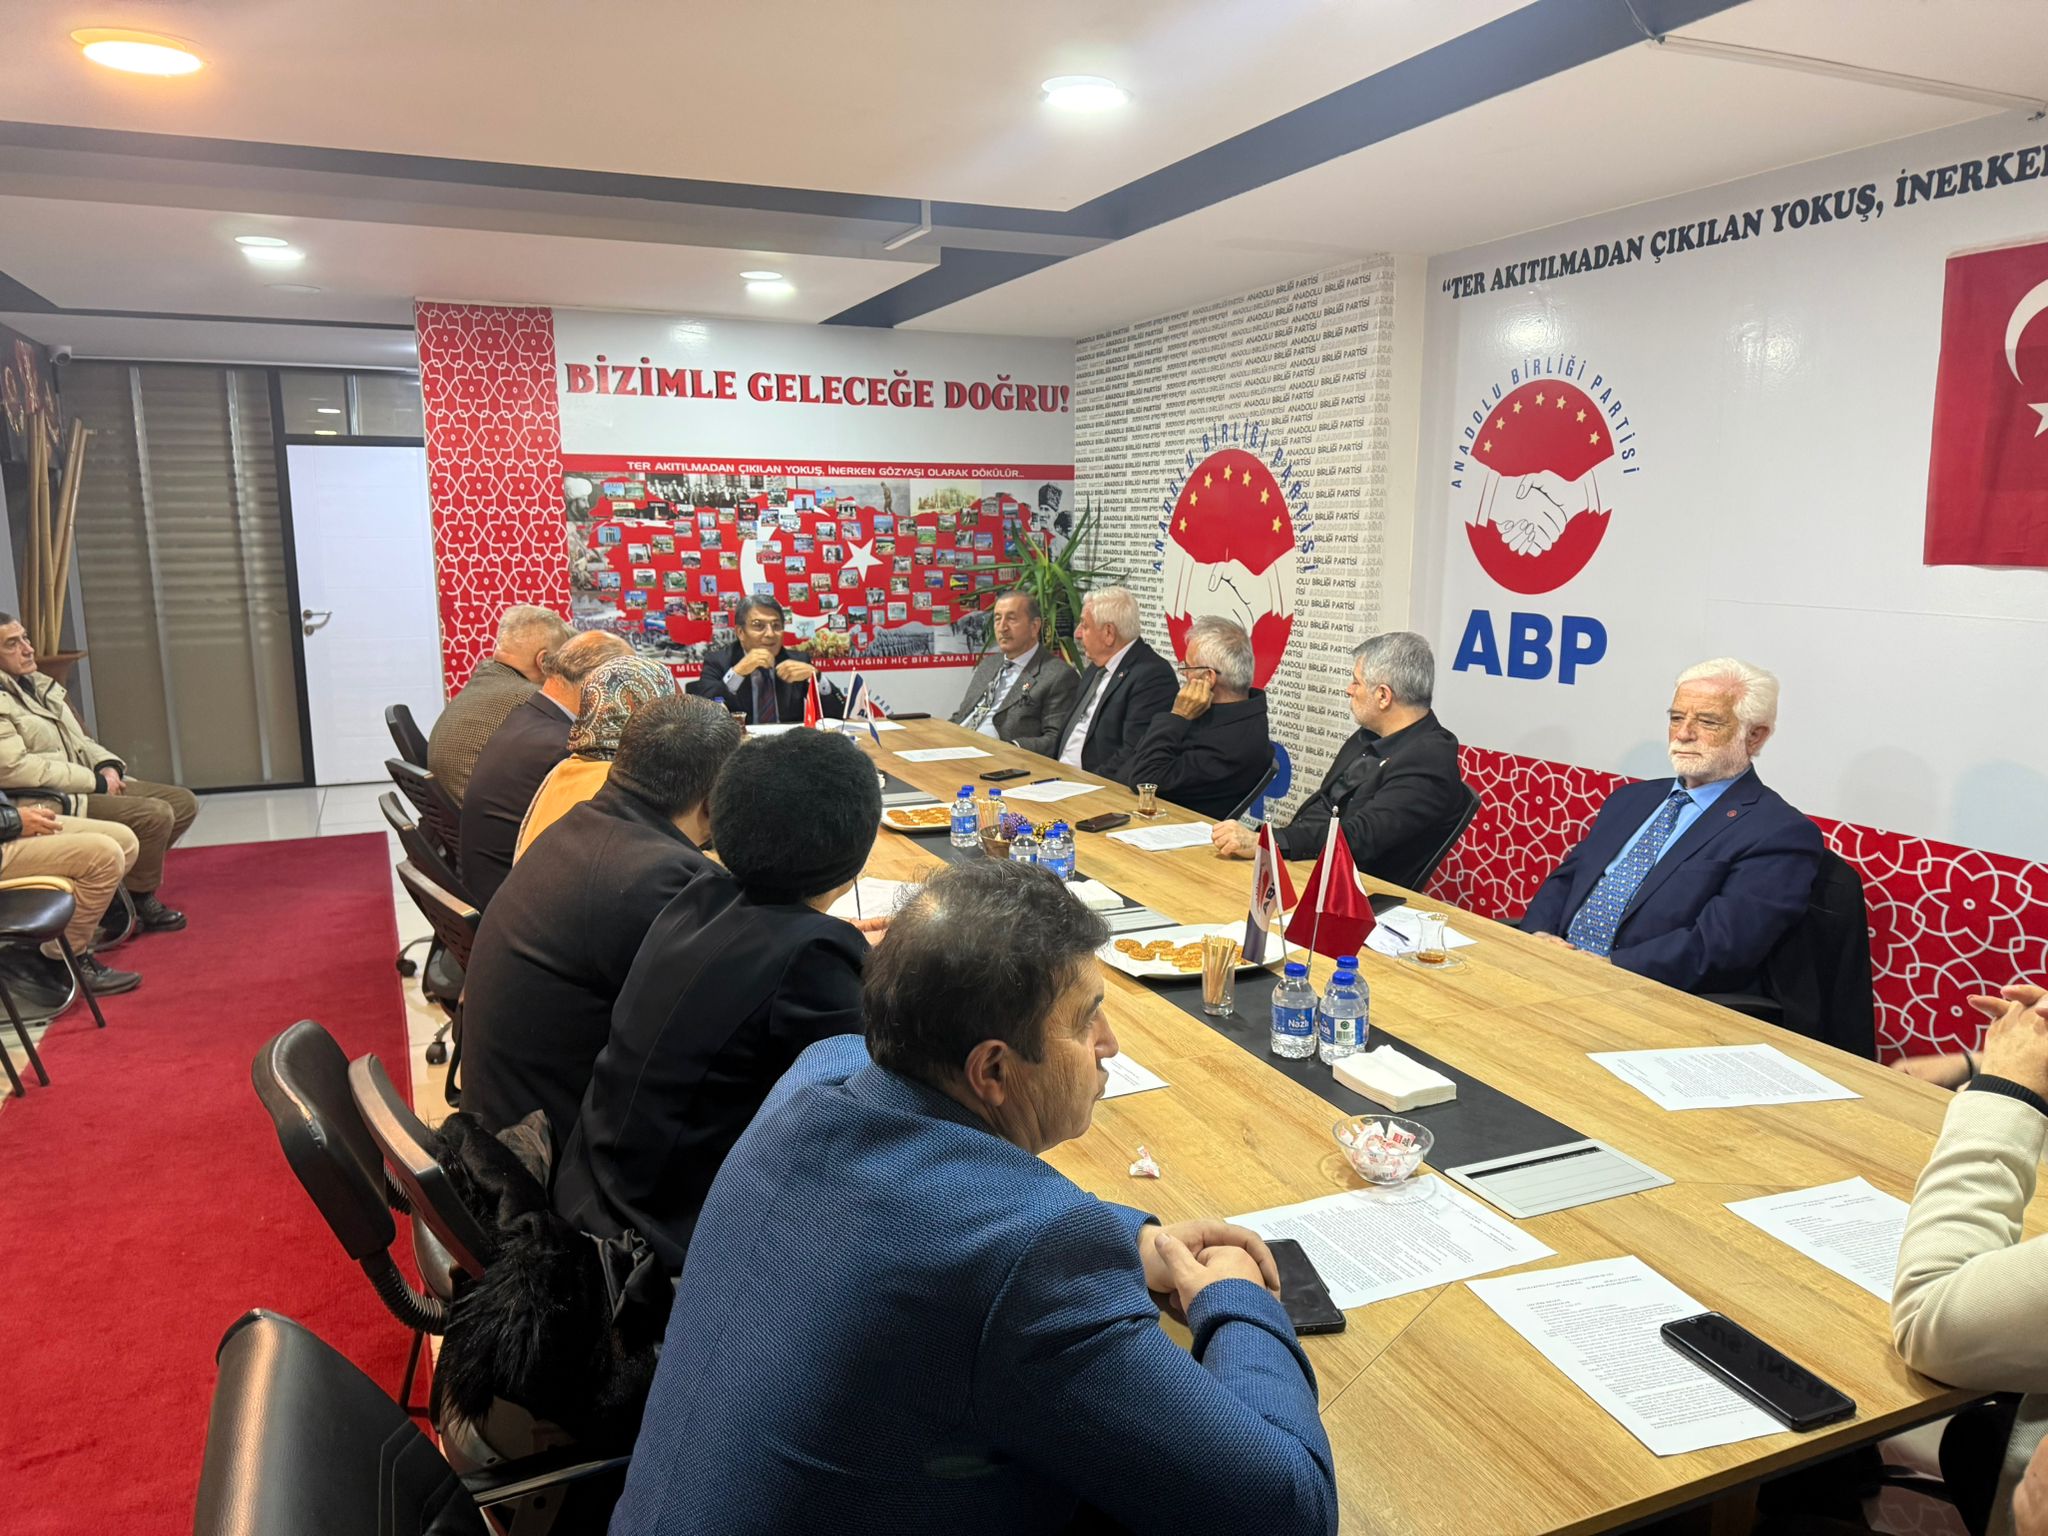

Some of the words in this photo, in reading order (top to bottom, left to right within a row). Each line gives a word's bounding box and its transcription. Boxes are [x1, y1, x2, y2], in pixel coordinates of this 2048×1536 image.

[1490, 236, 1644, 292] AKITILMADAN
[1650, 209, 1764, 263] ÇIKILAN
[1771, 184, 1884, 232] YOKUŞ,
[565, 354, 736, 400] BİZİMLE
[748, 370, 934, 408] GELECEĞE
[944, 374, 1070, 412] DOĞRU!
[1452, 384, 1502, 488] ANADOLU
[1511, 354, 1586, 385] BİRLİĞİ
[1591, 374, 1640, 474] PARTİSİ
[627, 462, 651, 470] TER
[655, 462, 734, 472] AKITILMADAN
[738, 464, 781, 474] ÇIKILAN
[828, 465, 875, 475] İNERKEN
[879, 467, 924, 477] GÖZYAŞI
[928, 468, 968, 476] OLARAK
[1153, 451, 1194, 571] ANADOLU
[1202, 419, 1268, 452] BİRLİĞİ
[1273, 447, 1318, 571] PARTİSİ
[834, 657, 887, 666] VARLIĞINI
[892, 656, 907, 664] HİÇ
[1452, 609, 1608, 685] ABP
[1263, 882, 1276, 915] AB
[1288, 1019, 1309, 1028] Nazlı
